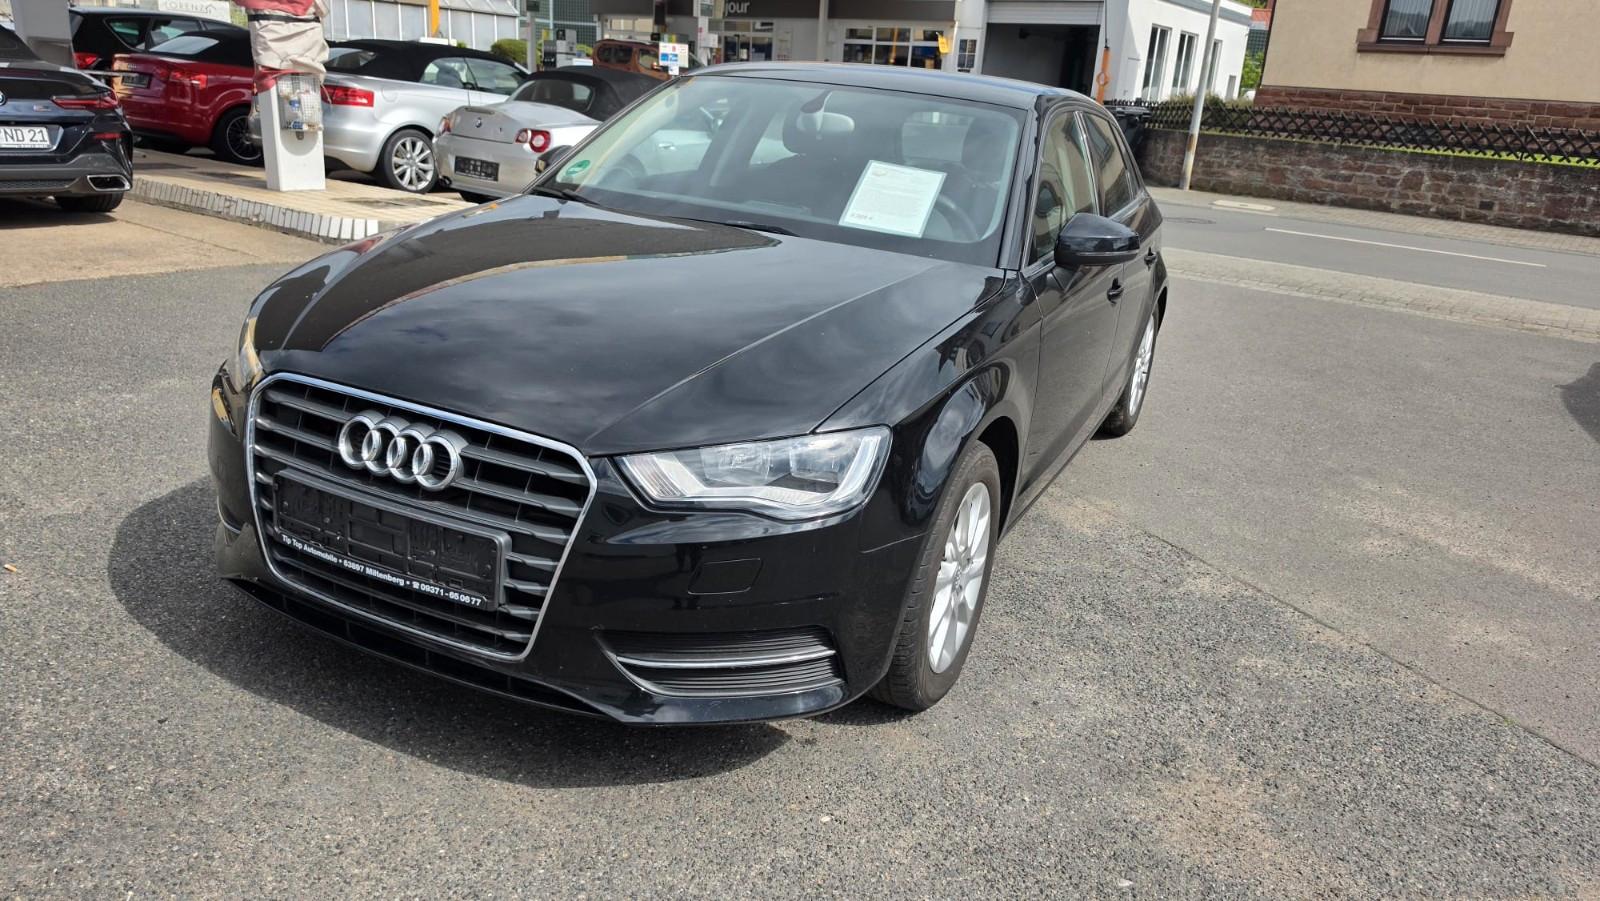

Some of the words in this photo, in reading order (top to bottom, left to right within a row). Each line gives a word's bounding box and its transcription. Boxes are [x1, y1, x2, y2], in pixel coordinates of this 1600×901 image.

[3, 128, 25, 142] ND
[27, 129, 48, 142] 21
[282, 533, 292, 545] Tip
[292, 538, 303, 550] Top
[303, 543, 338, 563] Automobile
[365, 567, 405, 586] Miltenberg
